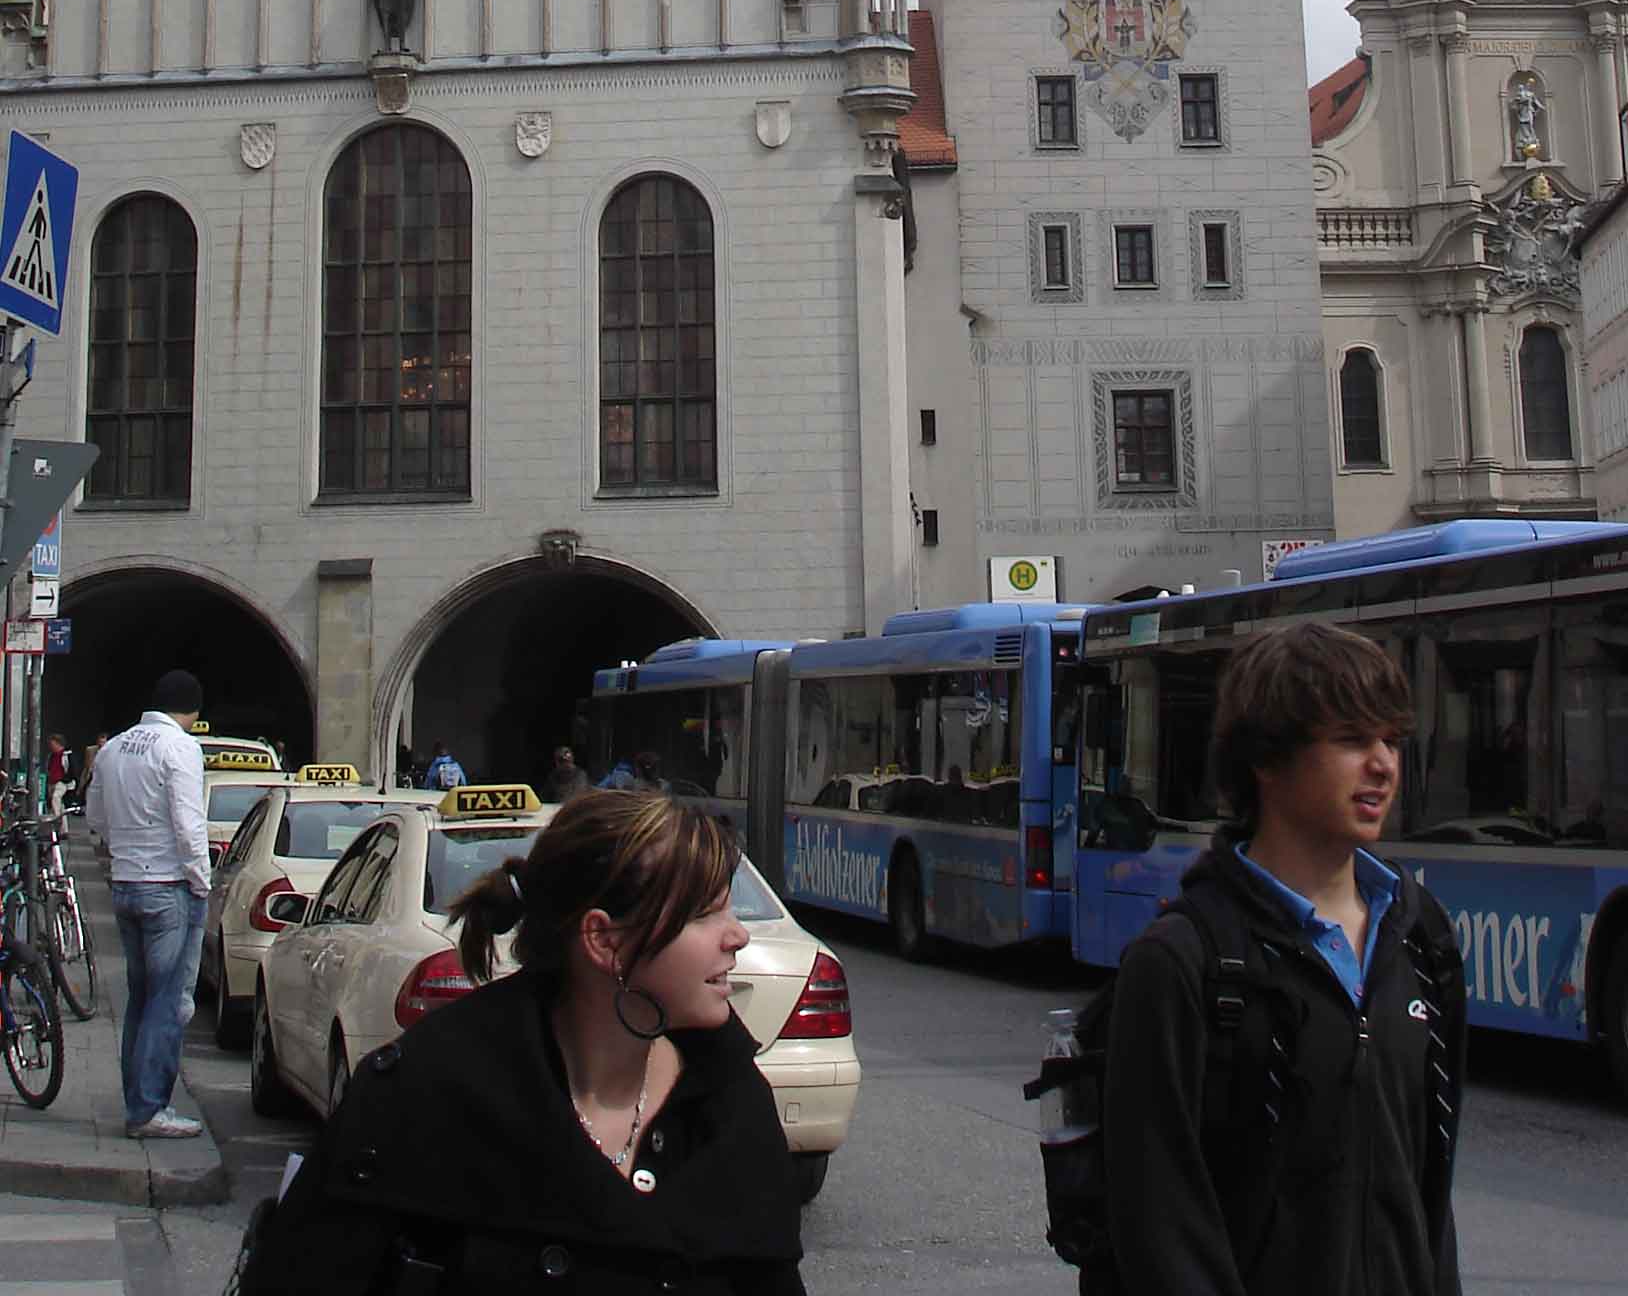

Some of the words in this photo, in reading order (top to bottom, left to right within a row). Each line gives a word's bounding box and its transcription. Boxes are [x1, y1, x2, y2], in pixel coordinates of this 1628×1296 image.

[35, 543, 58, 567] TAXI
[308, 768, 350, 781] TAXI
[460, 790, 524, 810] TAXI
[787, 821, 880, 909] Adelholzener
